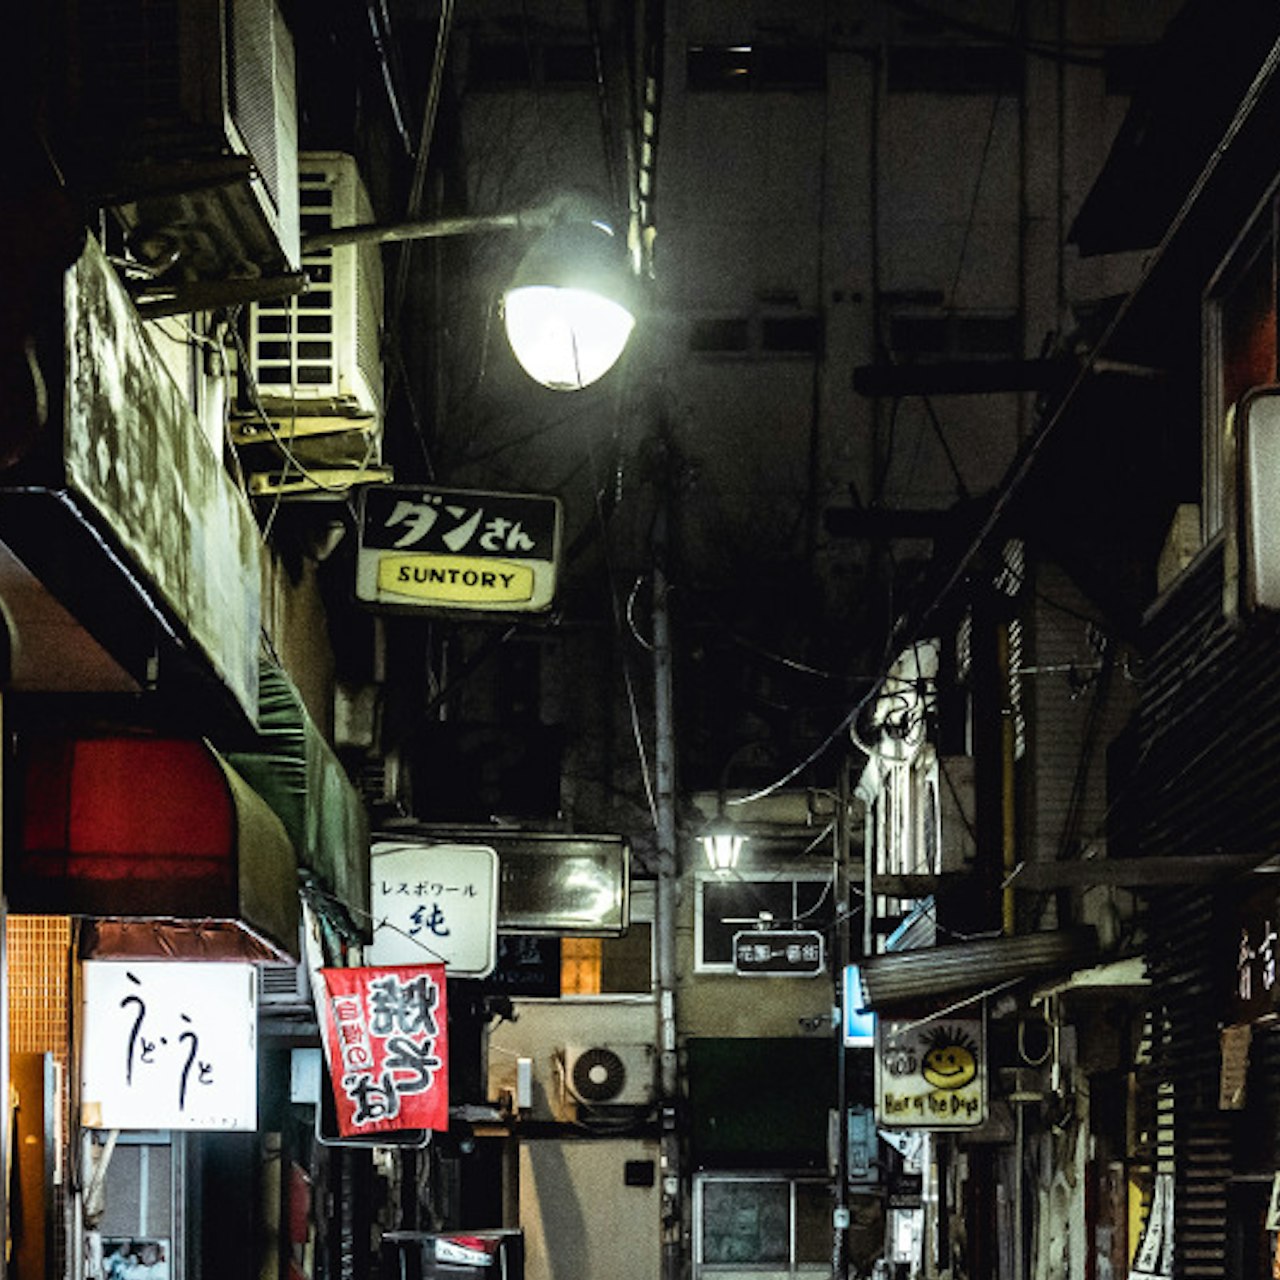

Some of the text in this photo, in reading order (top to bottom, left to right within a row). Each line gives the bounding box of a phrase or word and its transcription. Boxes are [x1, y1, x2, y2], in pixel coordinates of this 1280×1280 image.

[384, 493, 536, 552] ダンさん
[397, 565, 516, 589] SUNTORY
[409, 903, 451, 937] 純
